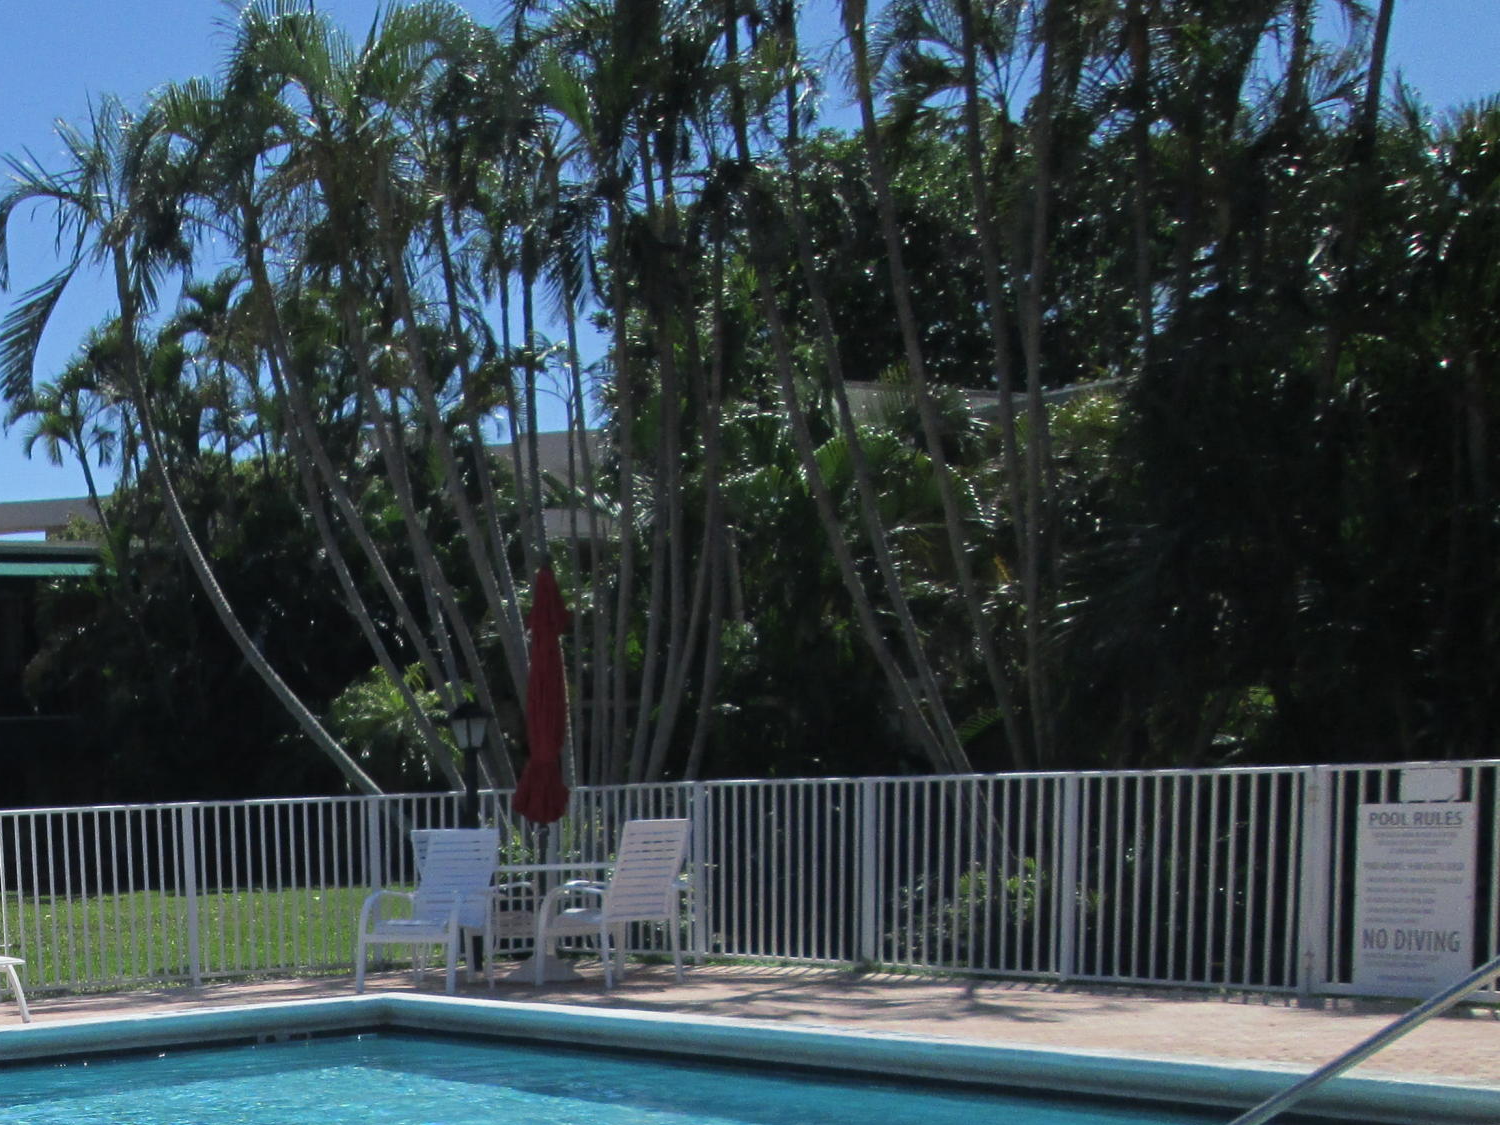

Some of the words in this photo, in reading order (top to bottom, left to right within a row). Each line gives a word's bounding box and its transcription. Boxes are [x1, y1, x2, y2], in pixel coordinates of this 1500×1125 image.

[1368, 812, 1409, 826] POOL
[1413, 811, 1463, 826] RULES
[1363, 928, 1388, 950] NO
[1394, 929, 1461, 952] DIVING
